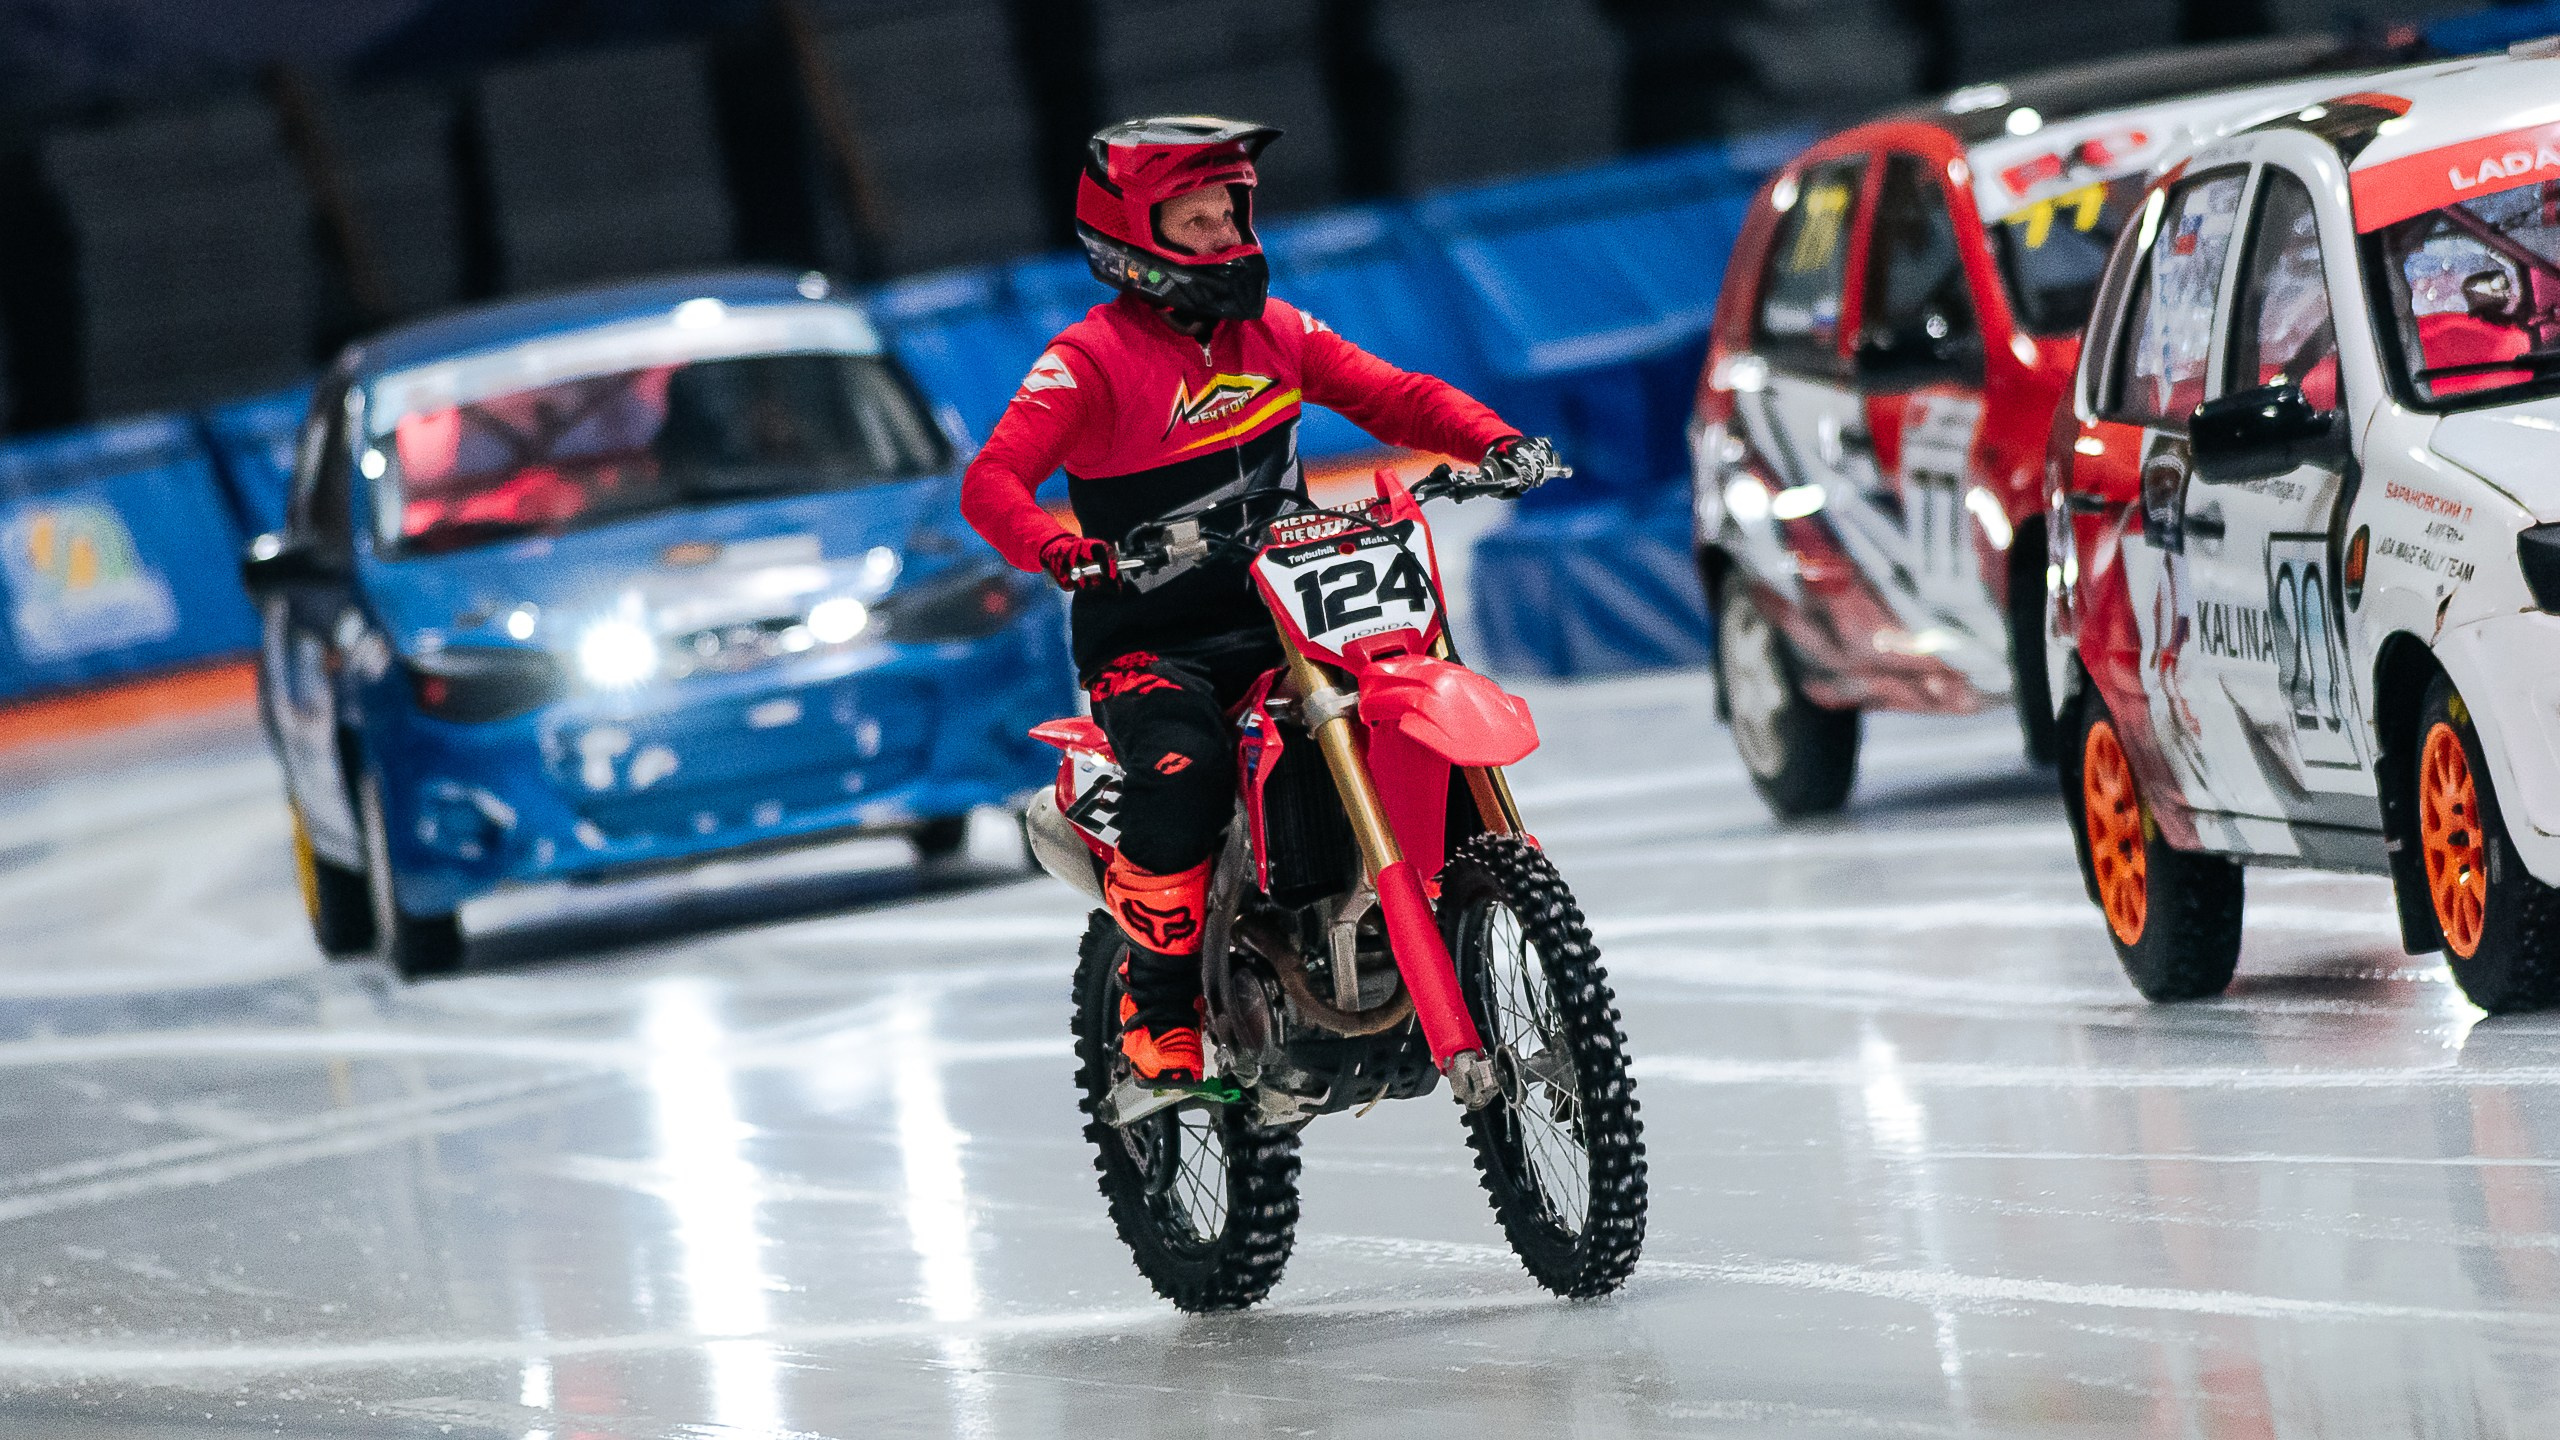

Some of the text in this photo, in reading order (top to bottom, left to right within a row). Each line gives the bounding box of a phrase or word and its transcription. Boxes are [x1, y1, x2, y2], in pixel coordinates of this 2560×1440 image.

[2447, 144, 2560, 191] LADA
[1360, 534, 1400, 547] Maks
[1293, 551, 1428, 640] 124
[1343, 620, 1414, 643] HONDA
[2196, 600, 2279, 665] KALINA
